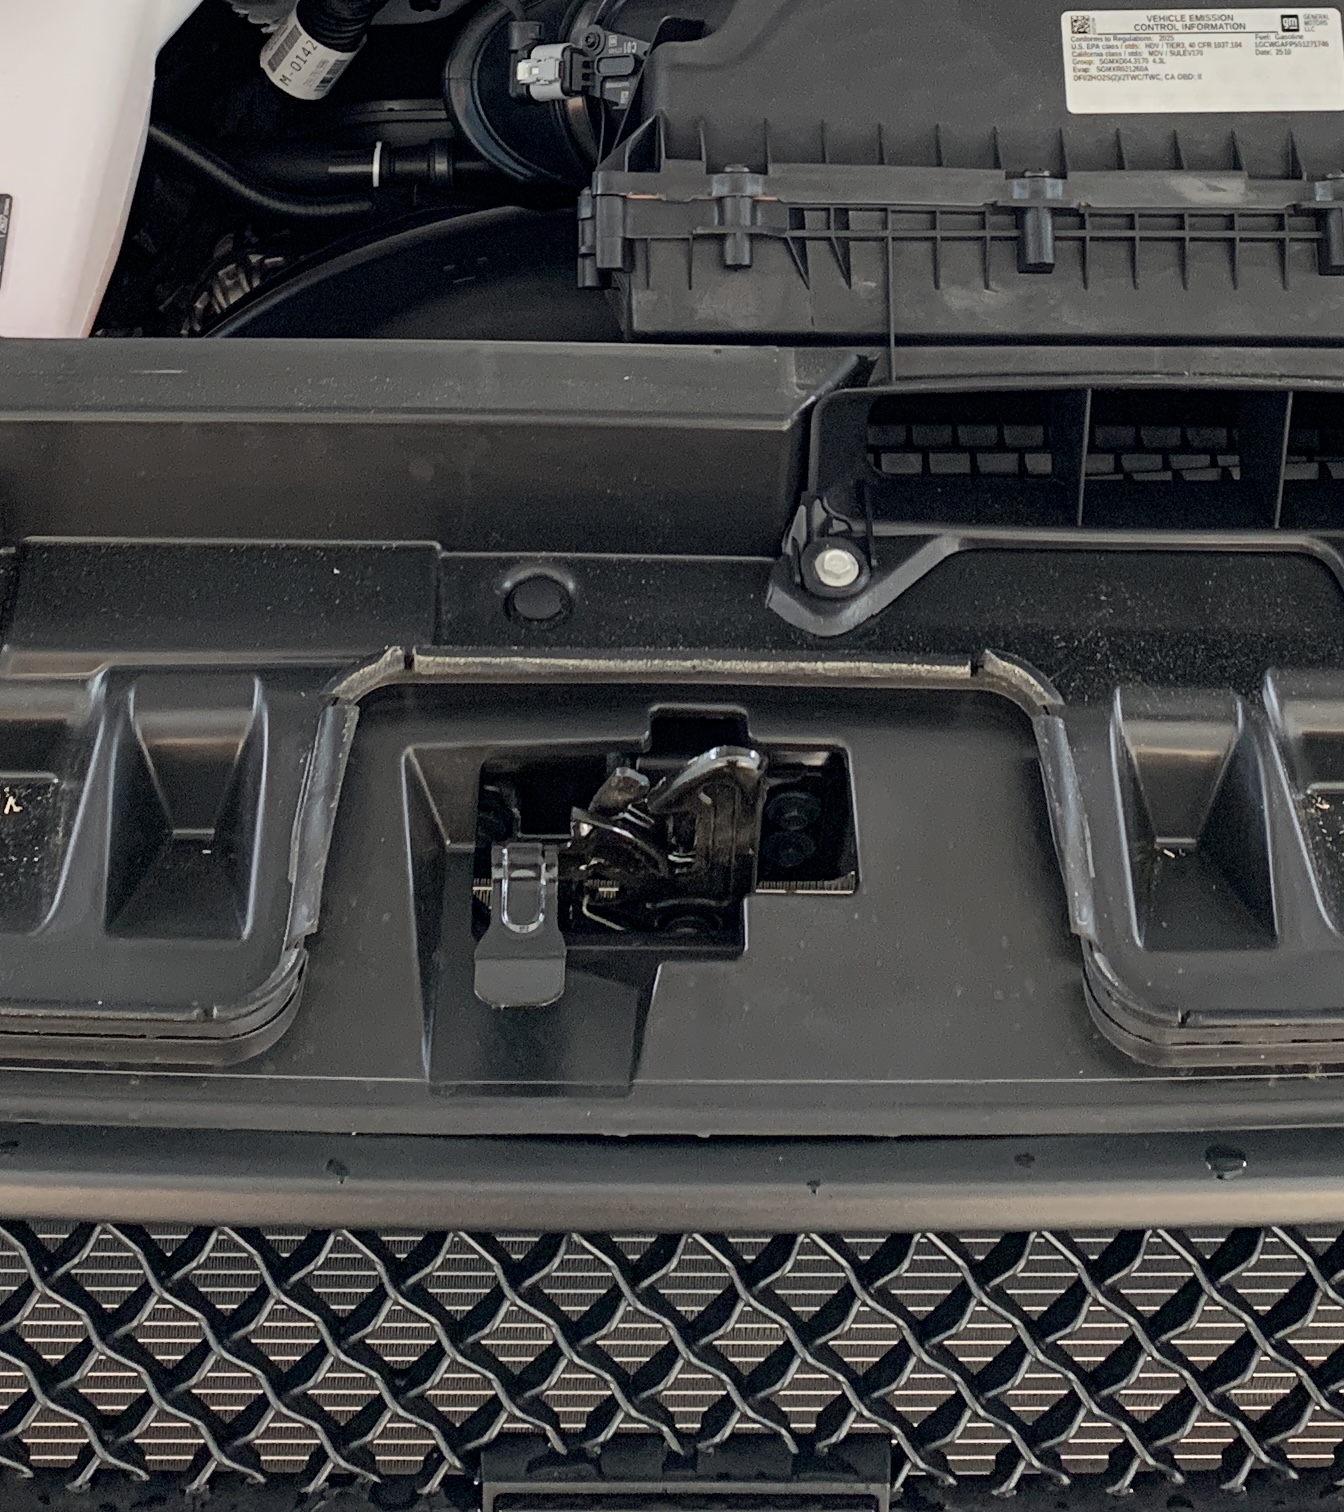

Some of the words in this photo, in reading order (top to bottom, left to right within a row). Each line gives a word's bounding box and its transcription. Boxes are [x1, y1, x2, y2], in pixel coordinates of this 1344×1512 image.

[1146, 14, 1187, 22] VEHICLE
[1189, 14, 1234, 22] EMISSION
[1134, 23, 1179, 31] CONTROL
[1181, 22, 1247, 31] INFORMATION
[278, 39, 319, 87] M-0142
